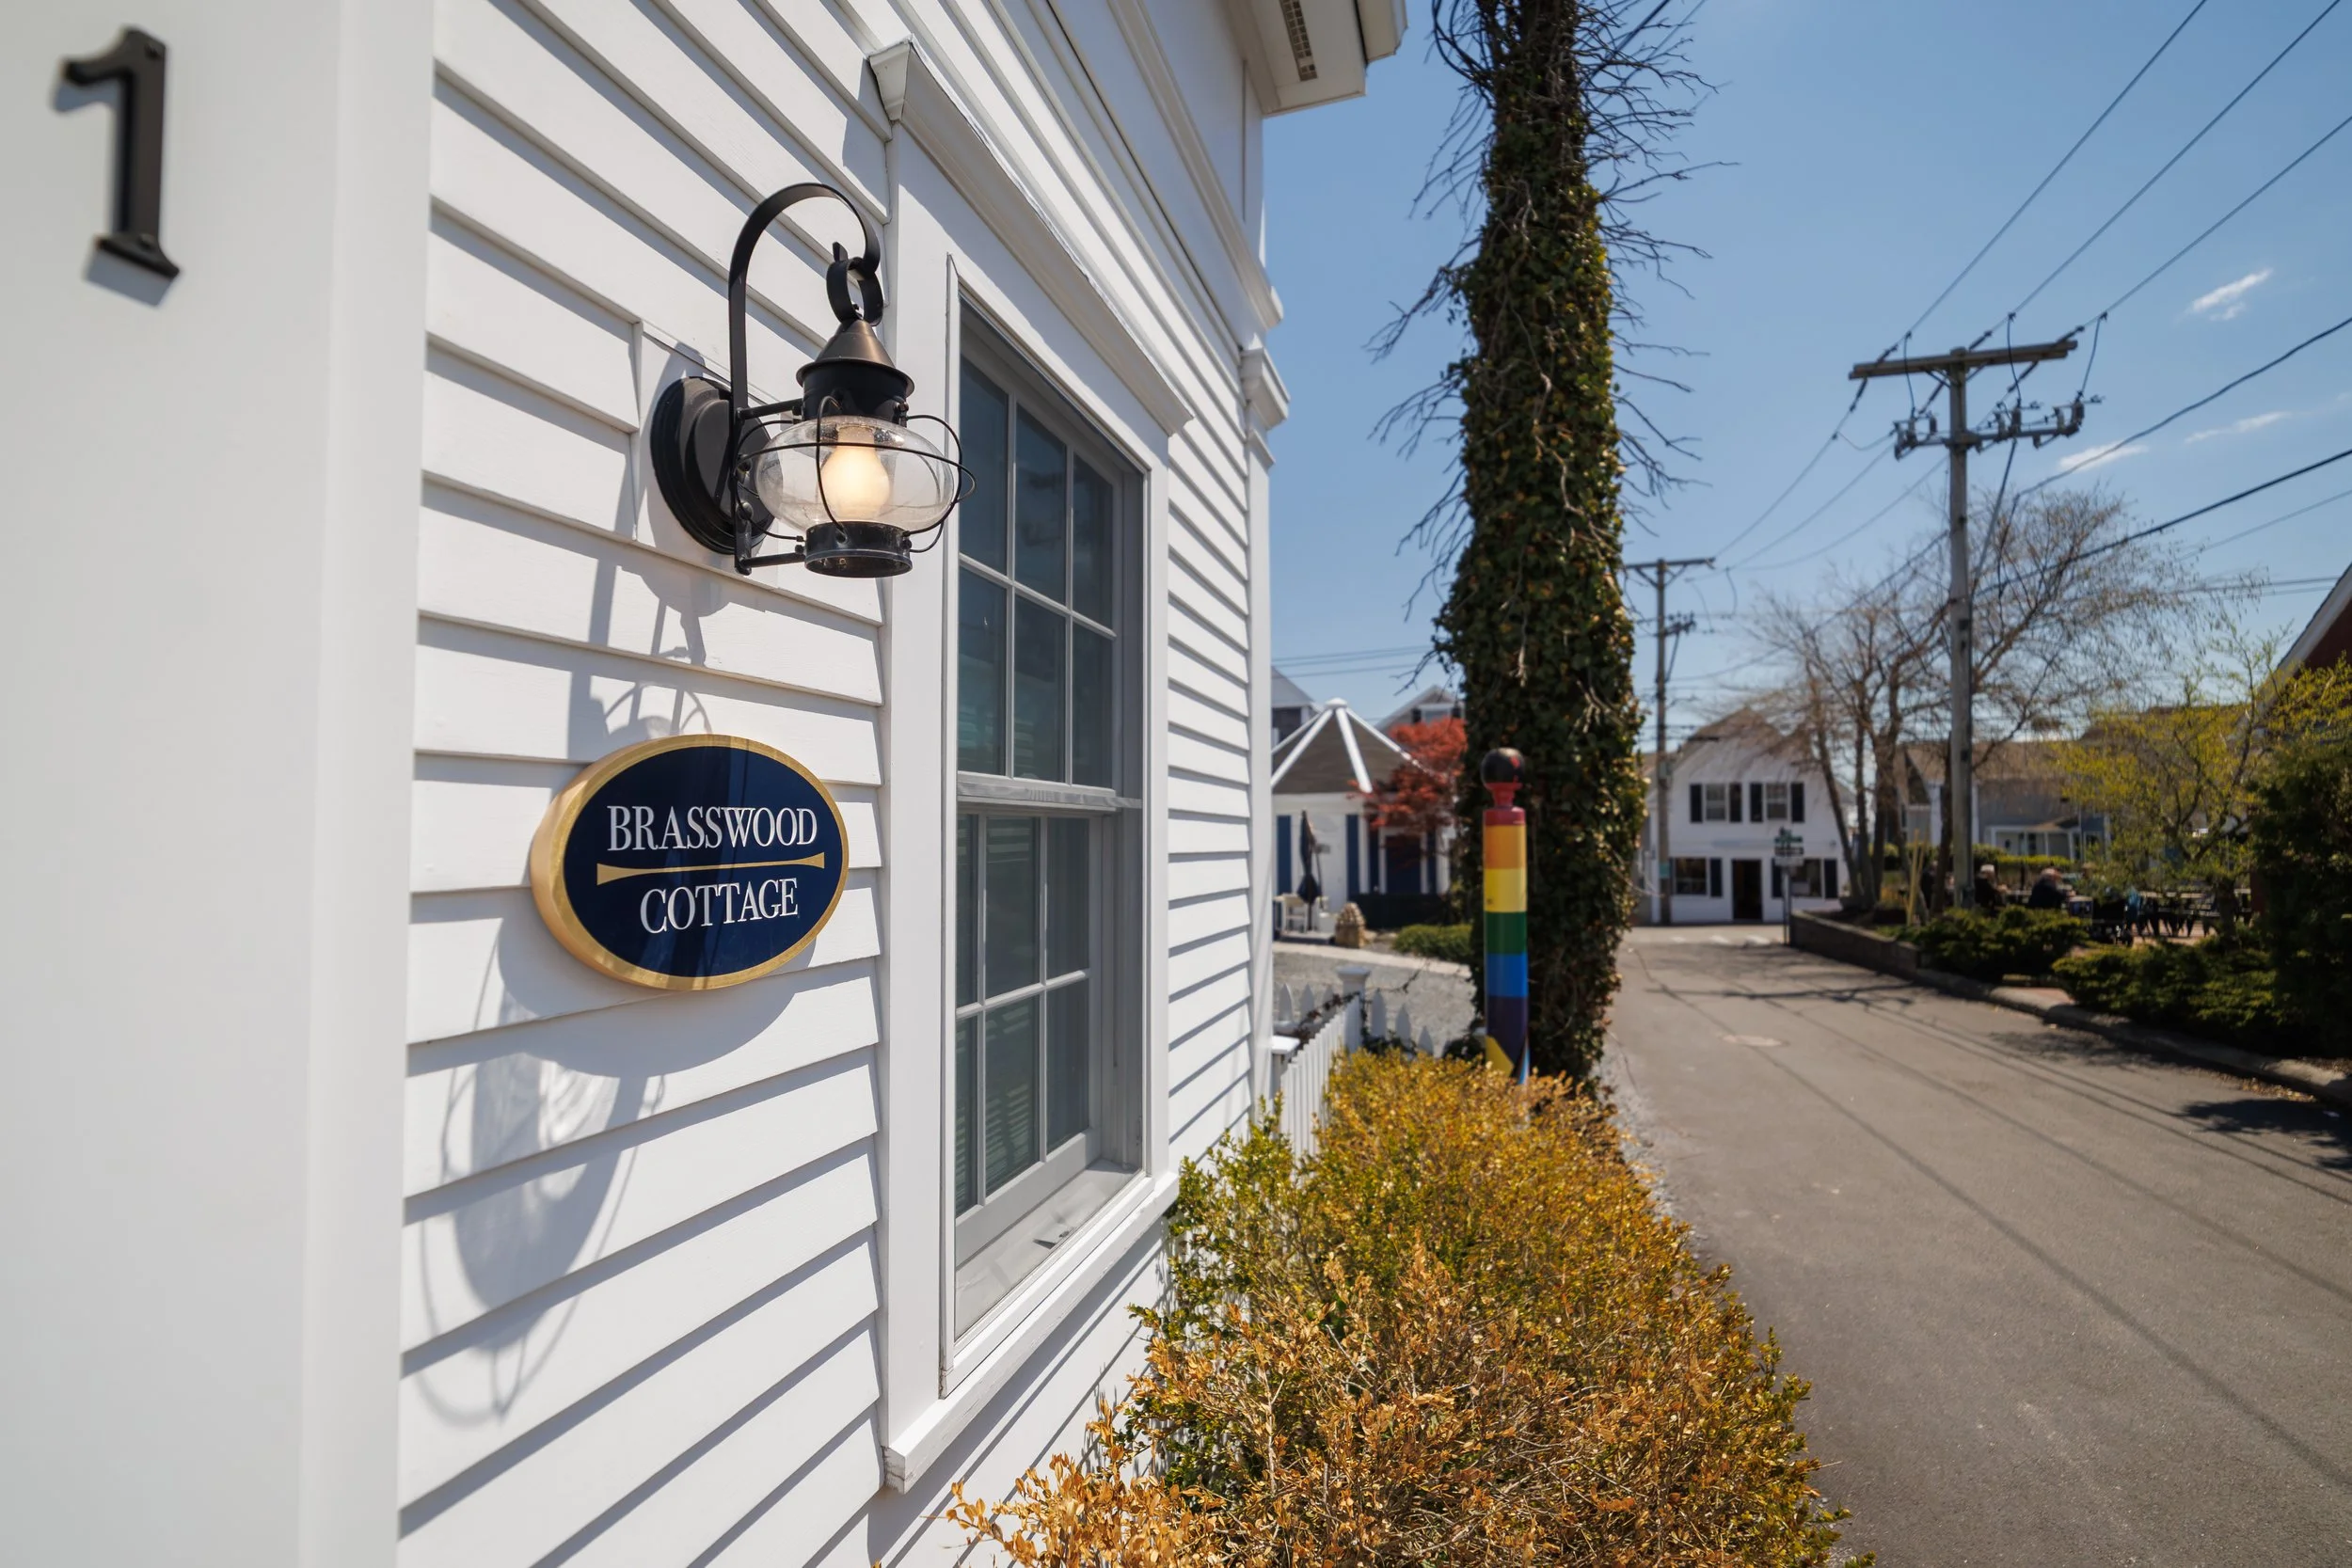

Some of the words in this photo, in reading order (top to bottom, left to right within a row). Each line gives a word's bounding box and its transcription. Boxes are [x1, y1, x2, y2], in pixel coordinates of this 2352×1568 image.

[62, 25, 181, 279] 1
[607, 805, 818, 851] BRASSWOOD
[640, 878, 799, 934] COTTAGE
